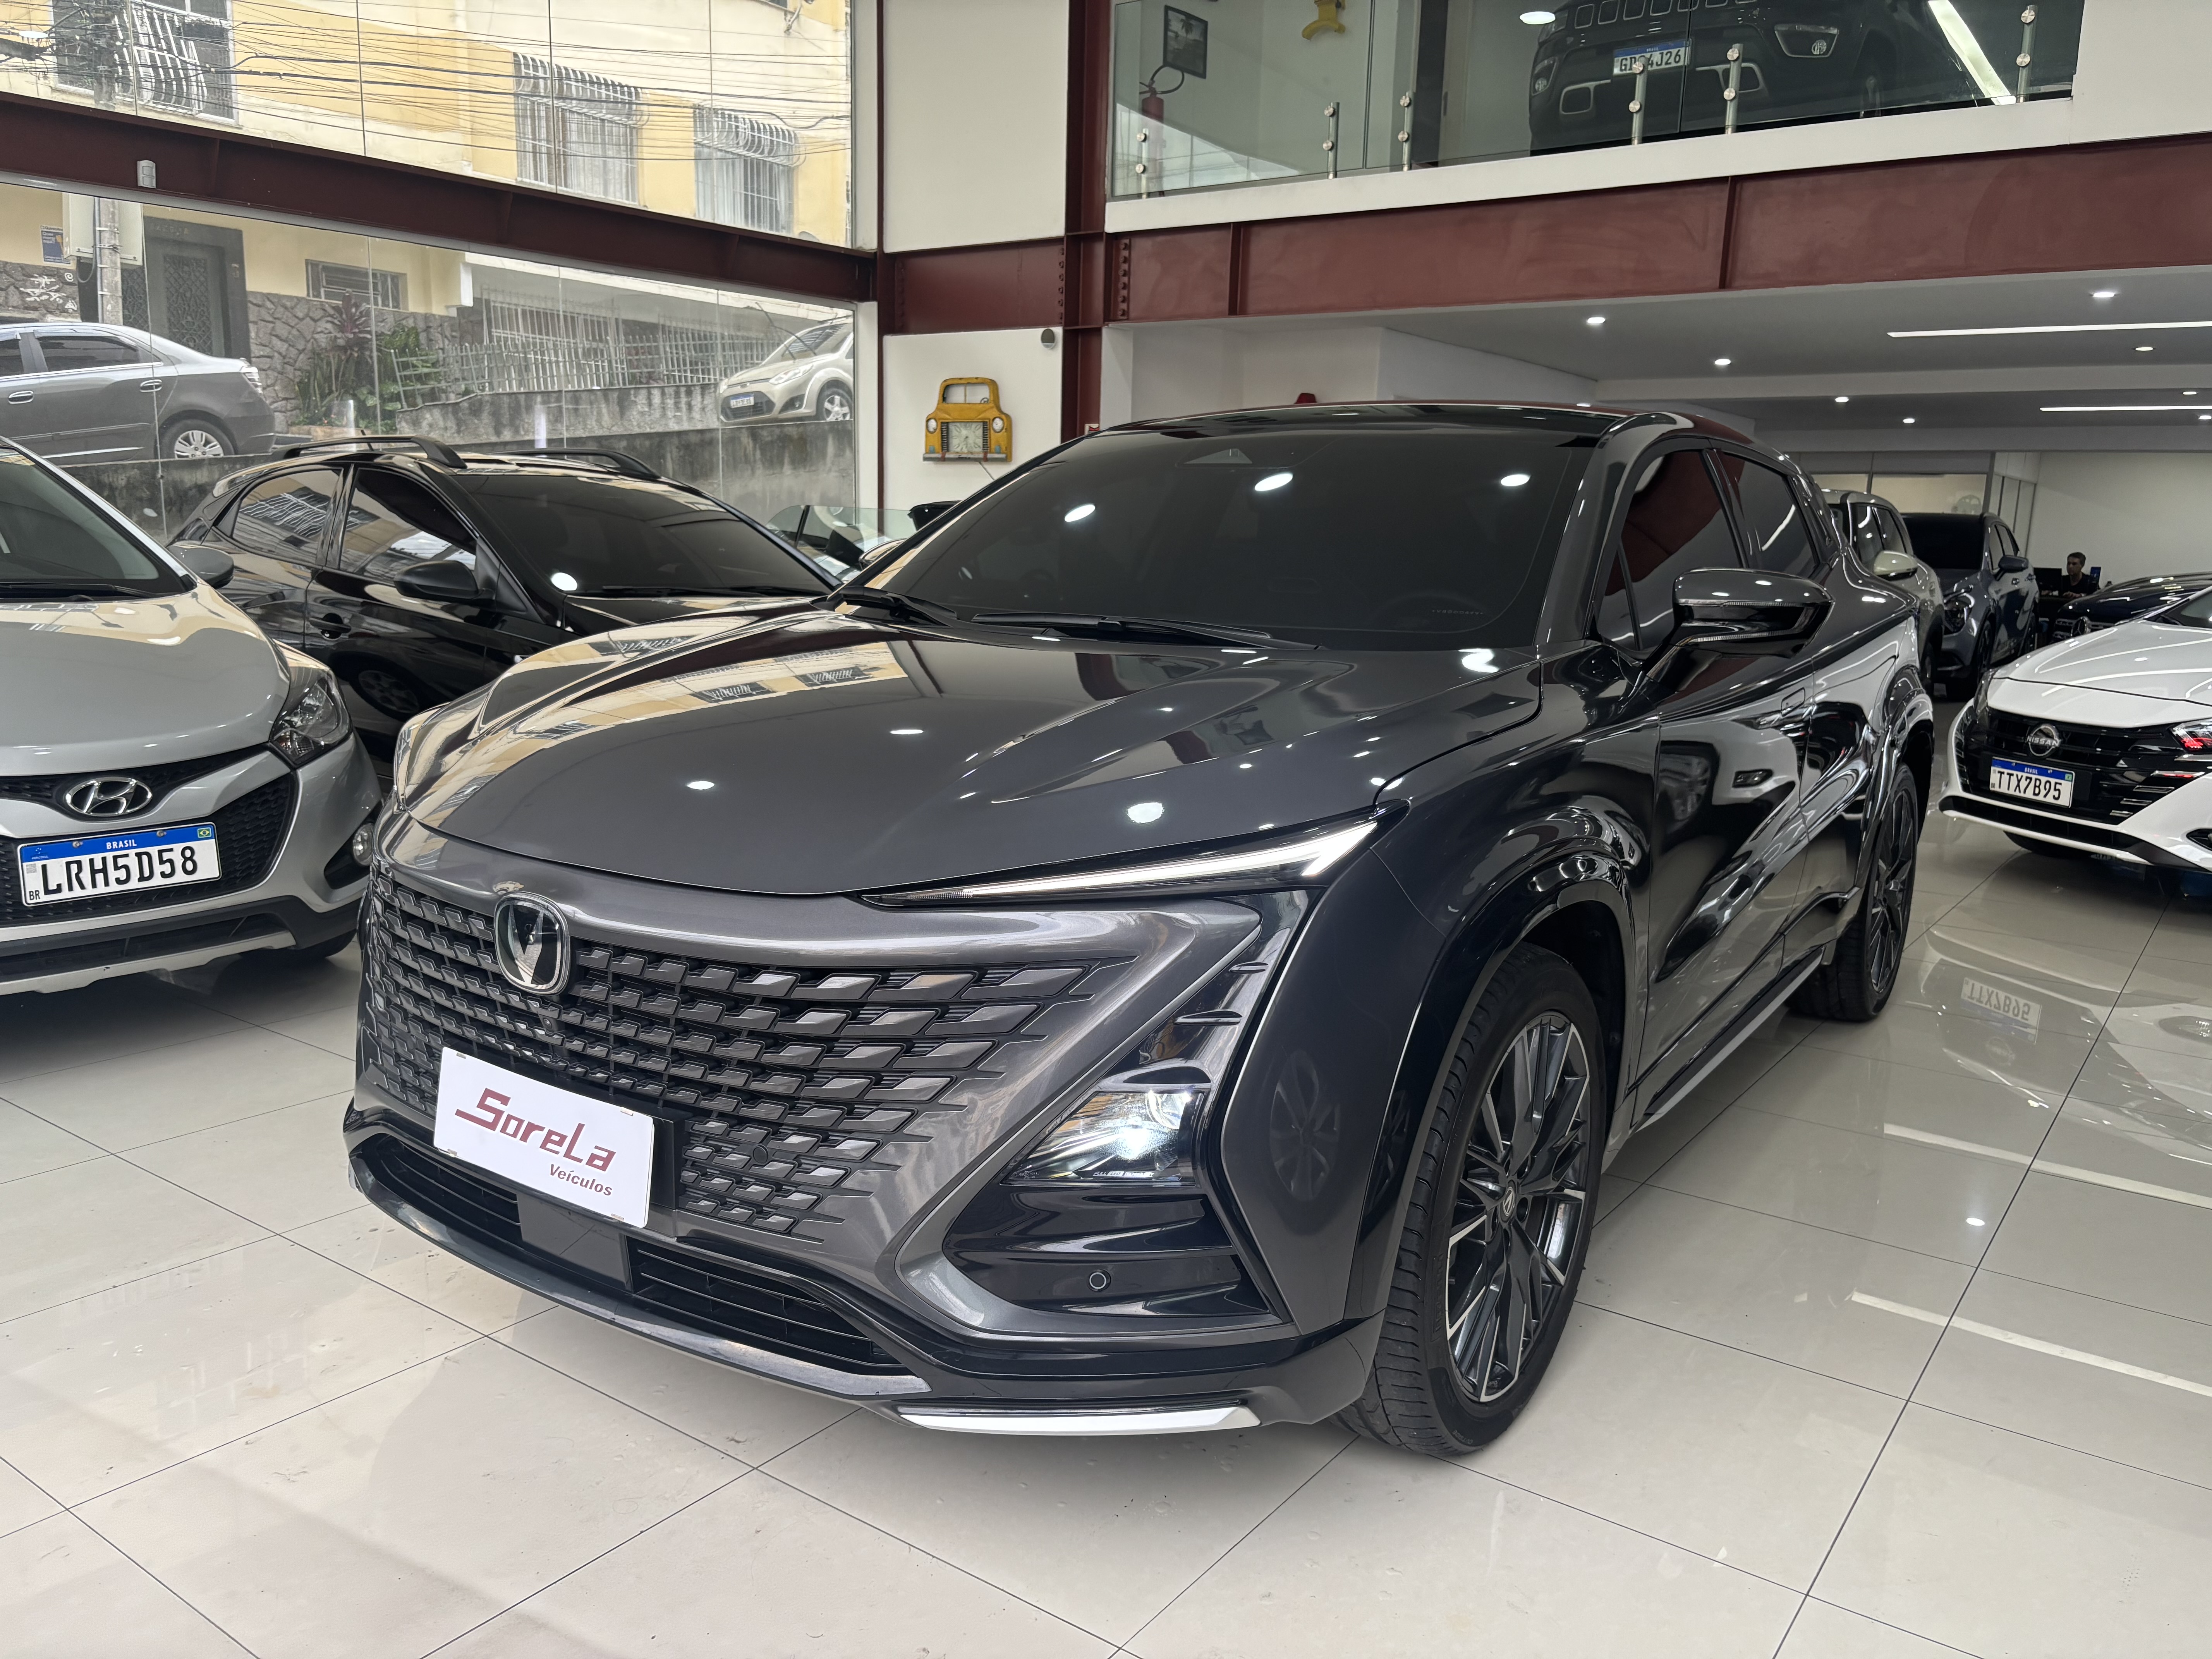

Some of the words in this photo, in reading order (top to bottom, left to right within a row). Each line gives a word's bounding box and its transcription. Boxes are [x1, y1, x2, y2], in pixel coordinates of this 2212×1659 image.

[2027, 735, 2060, 747] NISSAN
[1997, 770, 2062, 801] TTX7B95
[106, 840, 137, 850] BRASIL
[41, 846, 198, 896] LRH5D58
[29, 890, 40, 901] BR
[550, 1163, 613, 1196] Veículos
